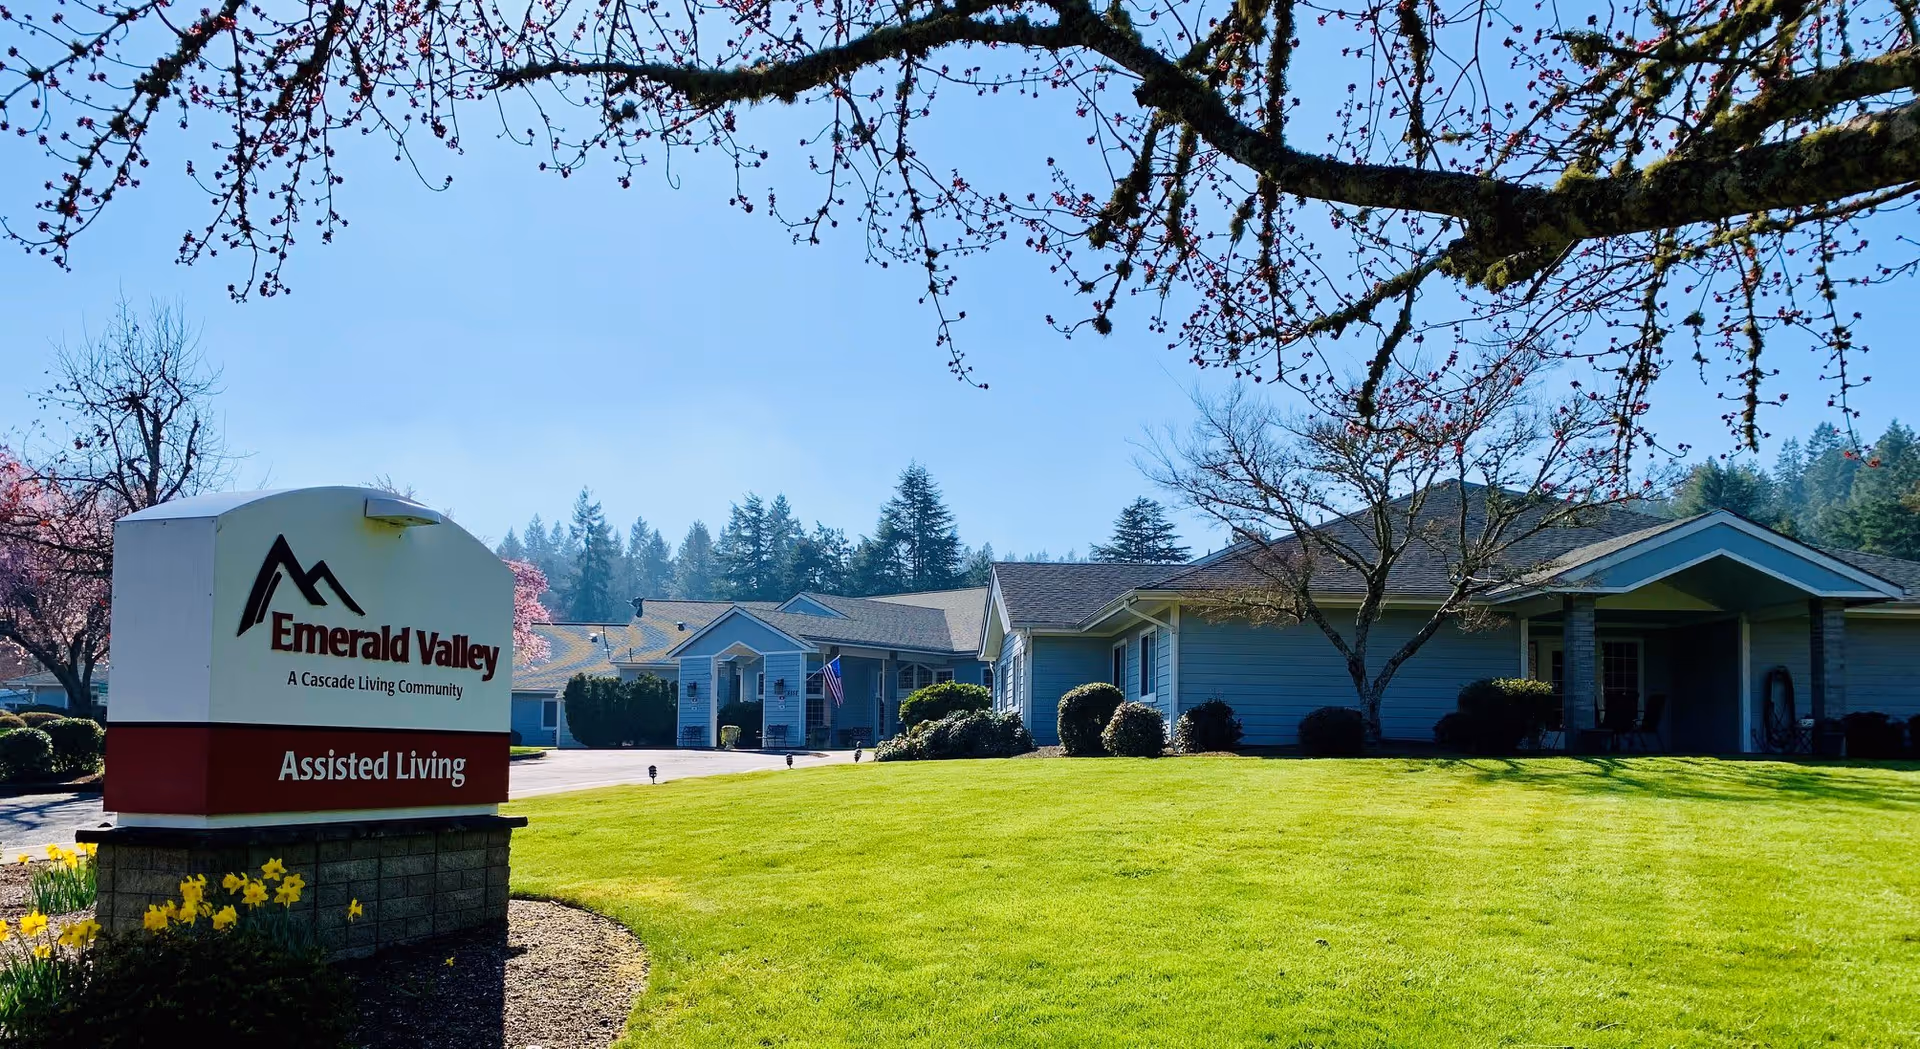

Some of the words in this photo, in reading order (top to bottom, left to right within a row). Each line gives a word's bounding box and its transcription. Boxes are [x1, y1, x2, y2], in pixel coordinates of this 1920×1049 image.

[271, 611, 410, 662] Emerald
[416, 630, 500, 681] Valley
[287, 671, 297, 685] A
[301, 672, 355, 689] Cascade
[358, 676, 395, 696] Living
[399, 680, 463, 700] Community
[278, 749, 389, 781] Assisted
[396, 751, 466, 787] Living
